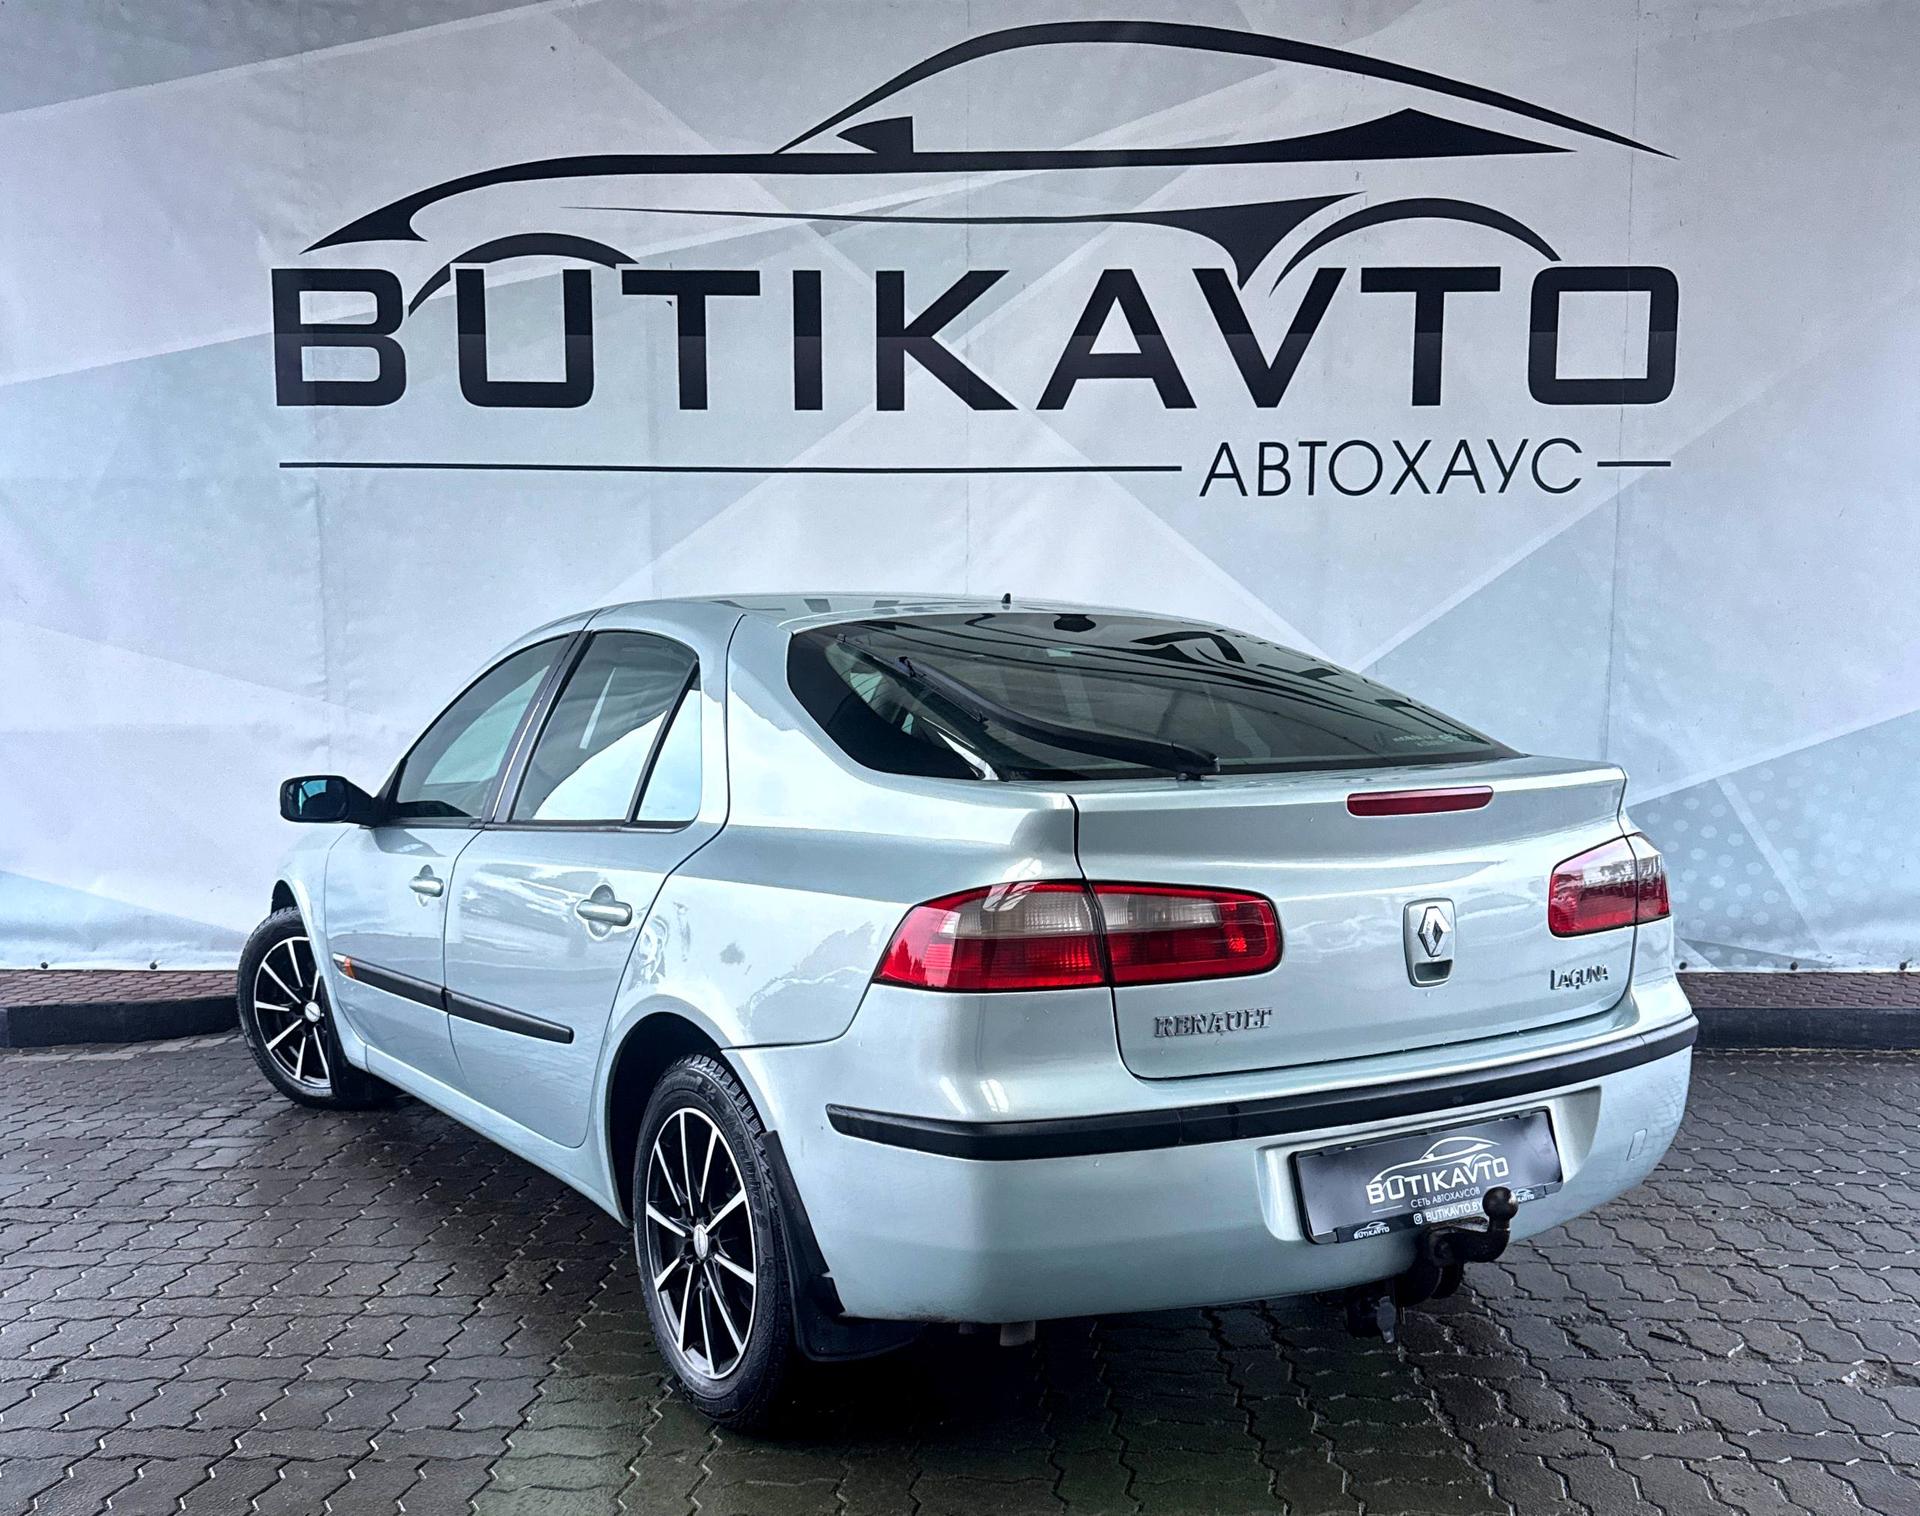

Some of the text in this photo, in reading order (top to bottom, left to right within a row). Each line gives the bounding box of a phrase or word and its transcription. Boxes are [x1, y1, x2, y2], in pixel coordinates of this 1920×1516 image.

[272, 266, 1680, 412] BUTIKAVTO
[1199, 438, 1583, 497] АВТОХАУС
[1550, 964, 1609, 991] LAGUNA
[1154, 1007, 1273, 1038] RENAULT
[1365, 1157, 1509, 1205] BUTIKAVTO
[1410, 1186, 1481, 1208] СЕТЬ АВТОХАУСОВ
